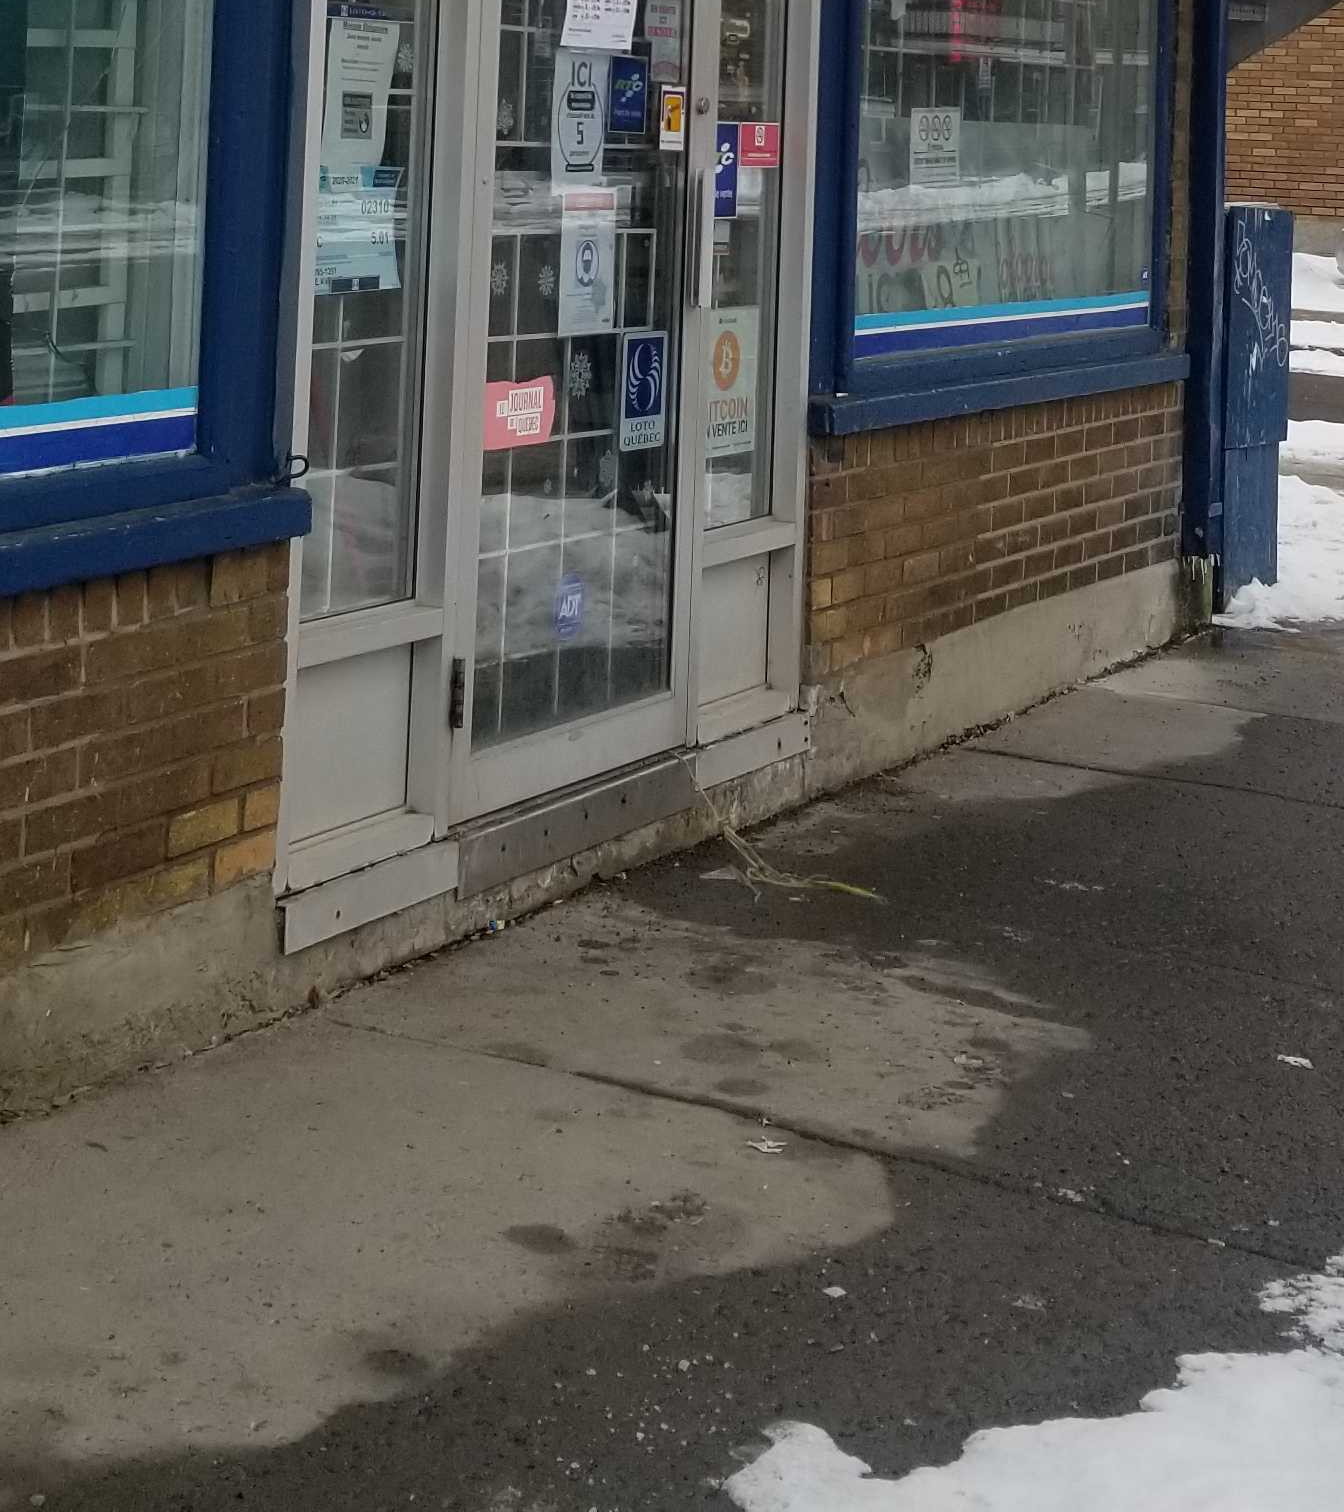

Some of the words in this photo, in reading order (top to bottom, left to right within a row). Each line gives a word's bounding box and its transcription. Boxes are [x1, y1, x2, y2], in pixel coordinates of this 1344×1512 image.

[571, 61, 593, 87] ICI
[576, 121, 585, 145] 5
[509, 389, 542, 414] JOURNAL
[630, 420, 656, 433] LOTO
[712, 421, 736, 438] VENTE
[738, 419, 748, 434] ICI
[558, 593, 582, 620] ADT
